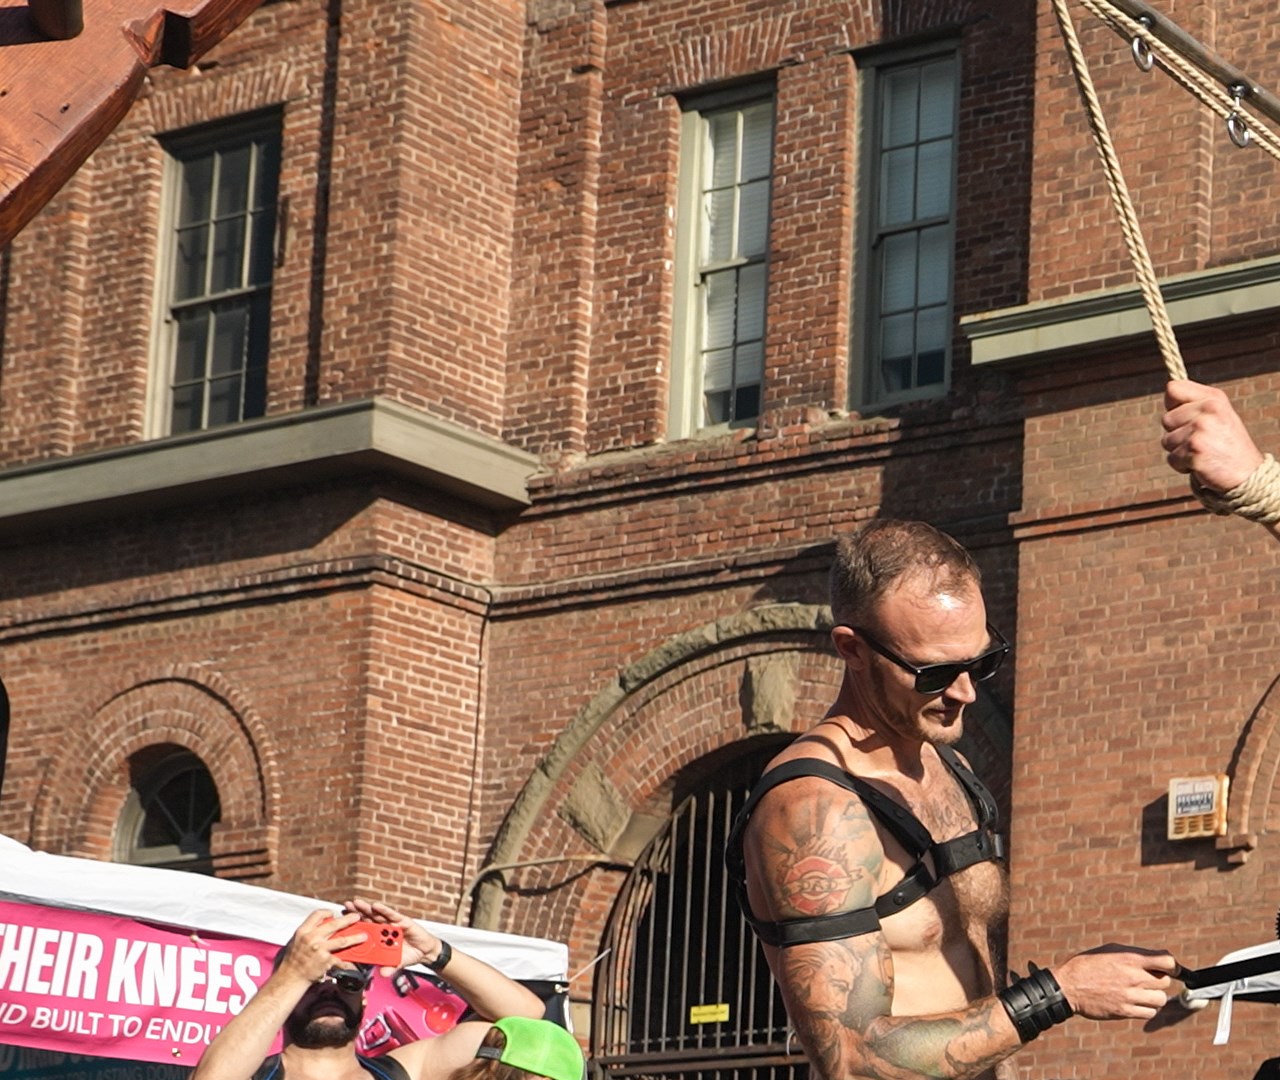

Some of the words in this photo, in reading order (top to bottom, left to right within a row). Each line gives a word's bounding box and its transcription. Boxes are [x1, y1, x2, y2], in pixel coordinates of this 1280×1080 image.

[106, 937, 261, 1016] KNEES
[31, 1006, 107, 1036] BUILT
[108, 1013, 143, 1038] TO
